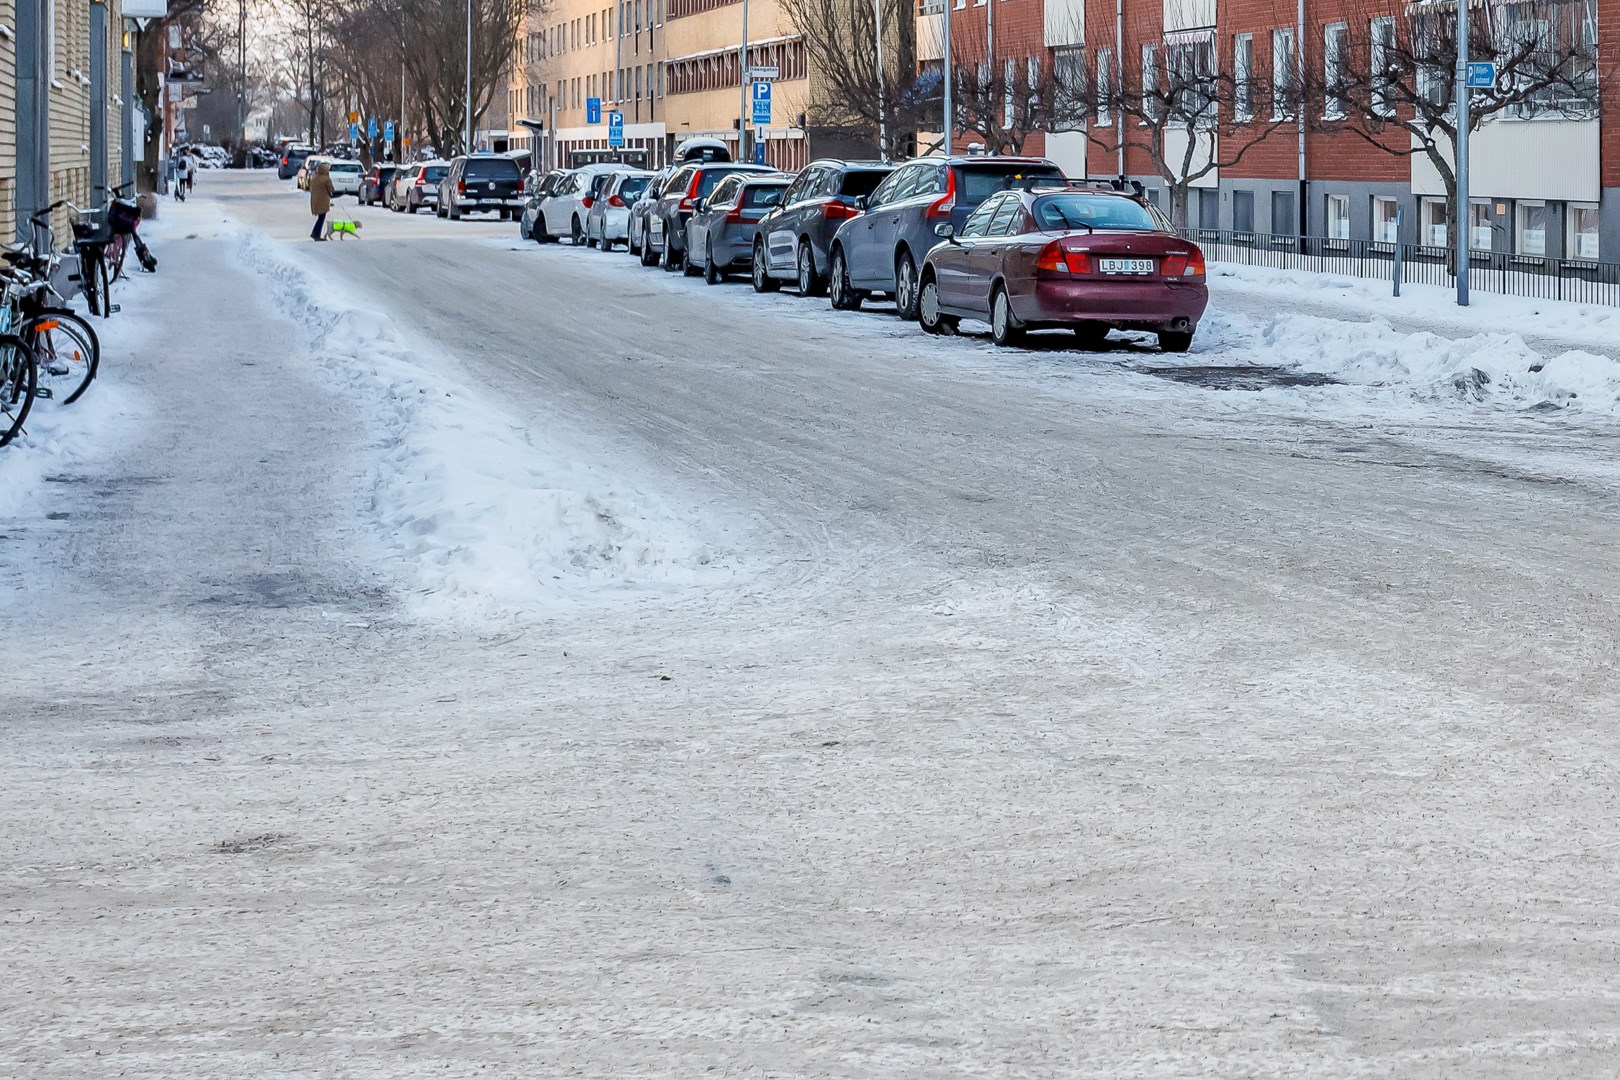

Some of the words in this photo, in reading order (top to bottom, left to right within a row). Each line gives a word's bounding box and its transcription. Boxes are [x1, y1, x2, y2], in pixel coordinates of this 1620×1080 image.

[1467, 65, 1474, 84] P
[757, 83, 769, 99] P
[612, 114, 622, 127] P
[1101, 260, 1123, 271] LBJ
[1131, 260, 1153, 271] 398
